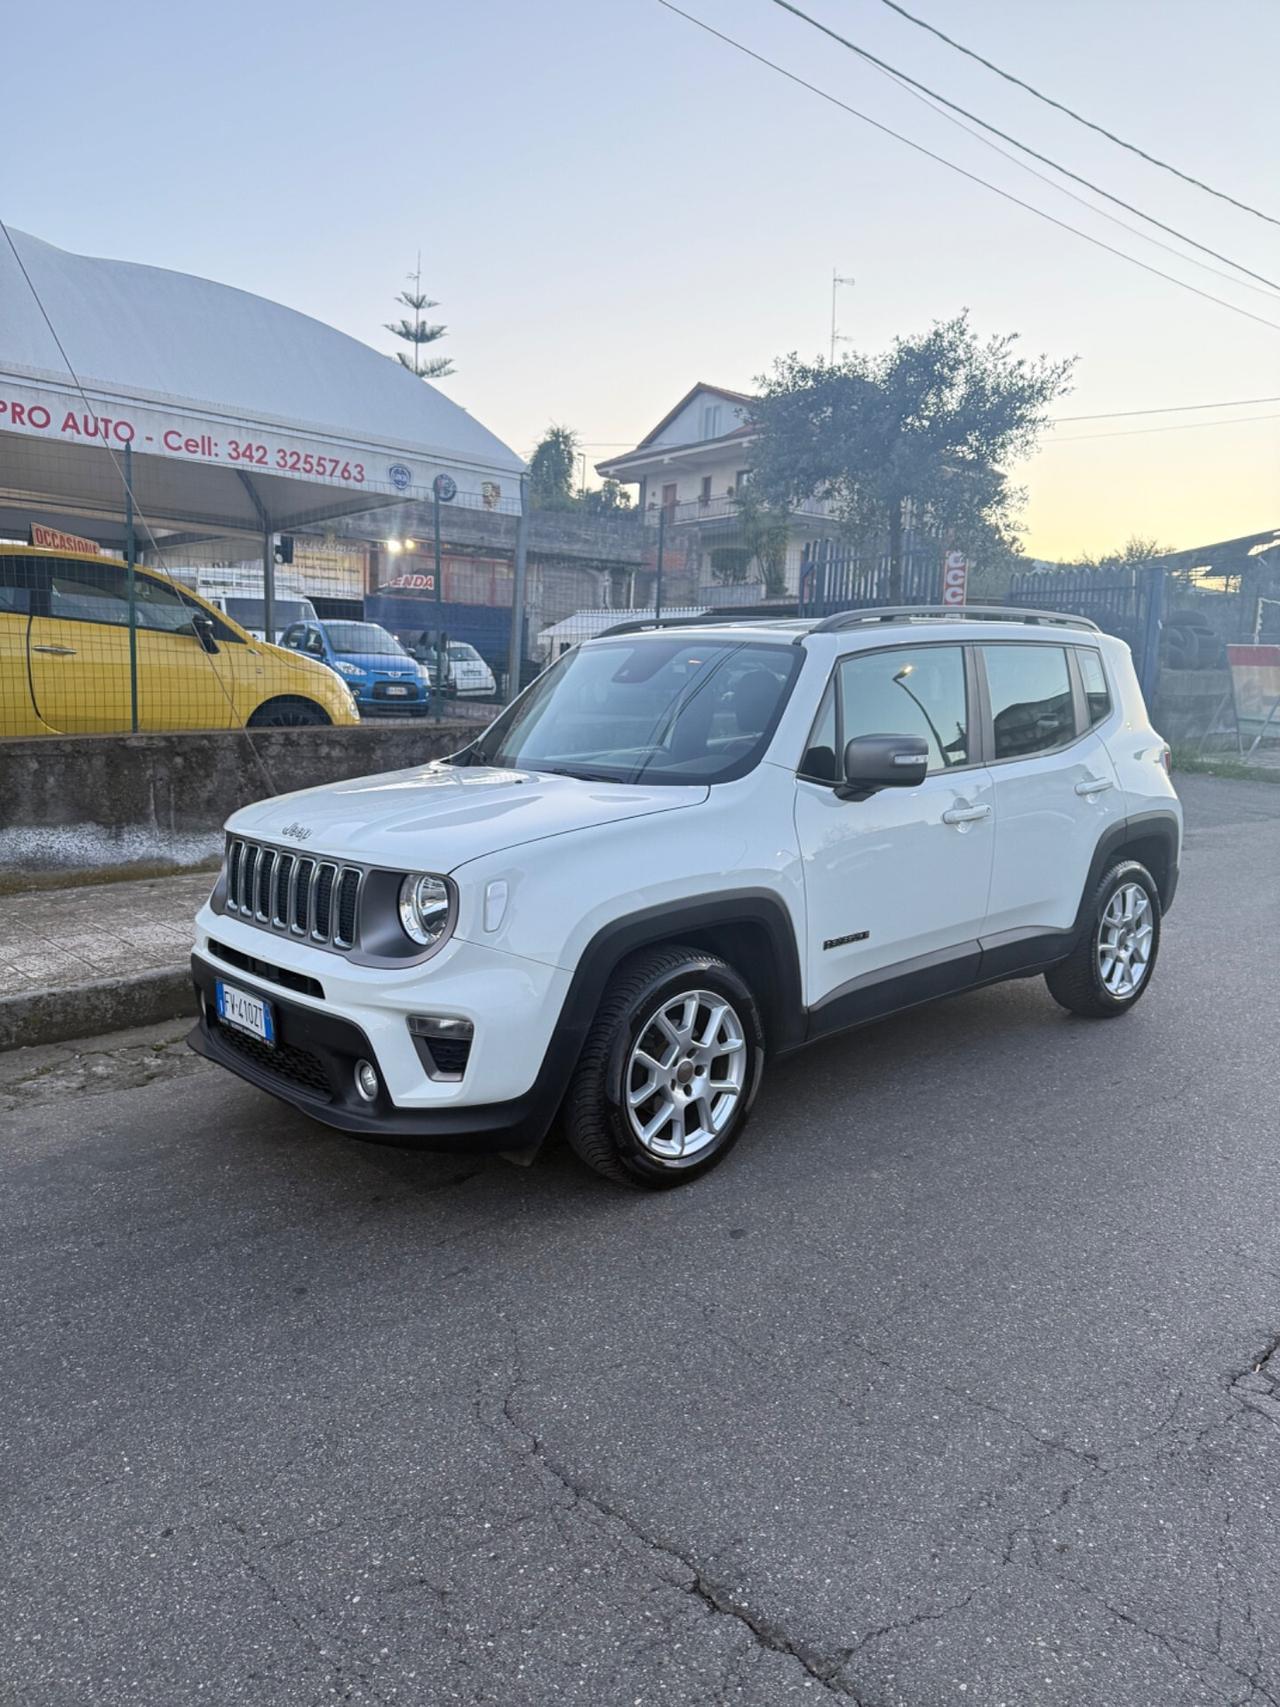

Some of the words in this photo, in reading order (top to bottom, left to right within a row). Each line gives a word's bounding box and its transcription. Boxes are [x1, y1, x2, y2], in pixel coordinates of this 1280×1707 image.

[61, 412, 135, 442] AUTO
[163, 430, 219, 457] Cell:
[227, 440, 269, 465] 342
[275, 448, 366, 483] 3255763
[282, 822, 312, 841] Jeep
